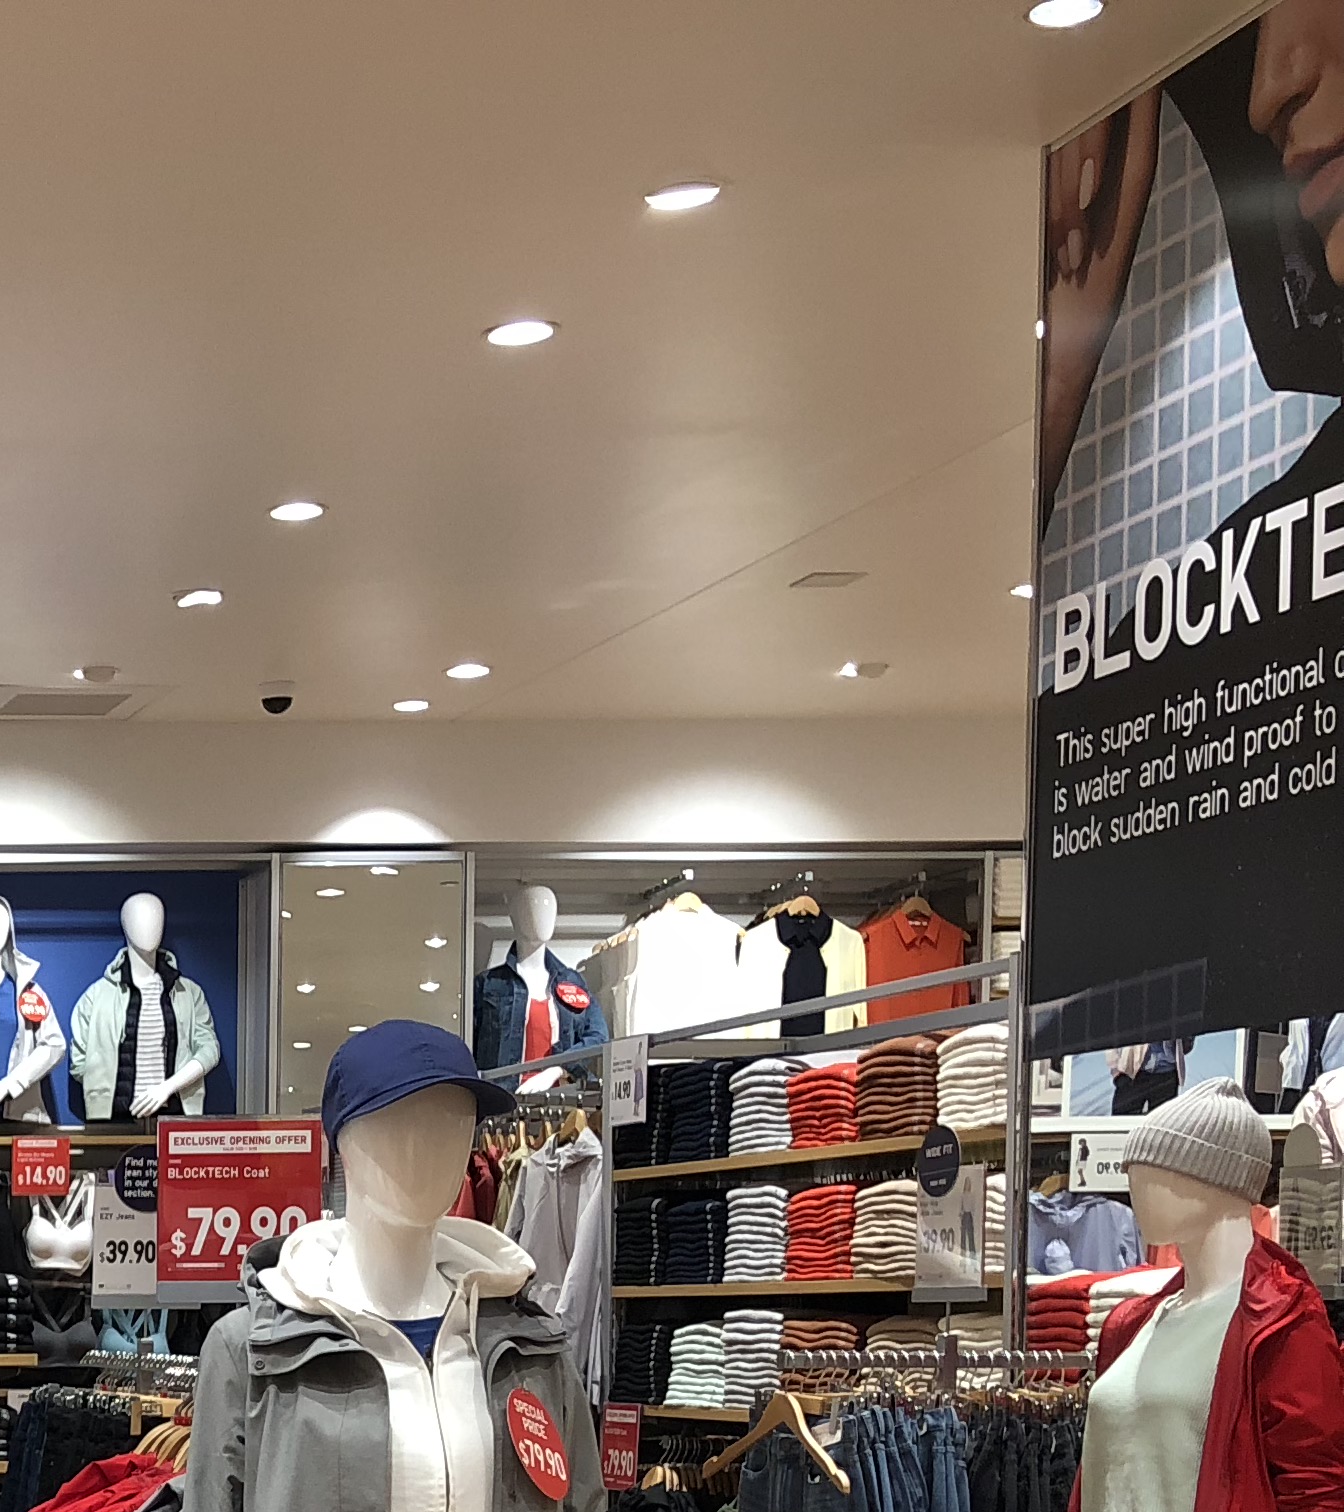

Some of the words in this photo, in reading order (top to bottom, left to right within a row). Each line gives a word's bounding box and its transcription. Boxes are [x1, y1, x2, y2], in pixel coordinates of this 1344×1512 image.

[1053, 483, 1344, 694] BLOCKTE
[1057, 718, 1093, 768] This
[1100, 711, 1155, 760] super
[1163, 689, 1206, 737] high
[1216, 647, 1325, 718] functional
[1054, 781, 1067, 813] is
[1075, 767, 1131, 808] water
[1139, 745, 1176, 789] and
[1185, 726, 1234, 774] wind
[1244, 706, 1304, 768] proof
[1315, 699, 1336, 736] to
[1052, 815, 1103, 859] block
[1110, 797, 1179, 844] sudden
[1188, 782, 1230, 823] rain
[1239, 763, 1279, 808] and
[1289, 746, 1336, 796] cold
[173, 1137, 225, 1147] EXCLUSIVE
[229, 1136, 271, 1145] OPENING
[275, 1135, 307, 1144] OFFER
[124, 1167, 143, 1179] jean
[125, 1157, 143, 1167] Find
[168, 1167, 239, 1179] BLOCKTECH
[243, 1166, 269, 1178] Coat
[18, 1166, 66, 1186] $14.90
[124, 1179, 132, 1187] in
[123, 1188, 155, 1198] section.
[116, 1213, 135, 1221] Jeans
[171, 1206, 307, 1258] $79.90
[99, 1240, 155, 1264] $39.90
[513, 1398, 548, 1425] SPECIAL
[522, 1417, 547, 1440] PRICE
[518, 1439, 566, 1481] $79.90
[604, 1449, 633, 1477] $79.90
